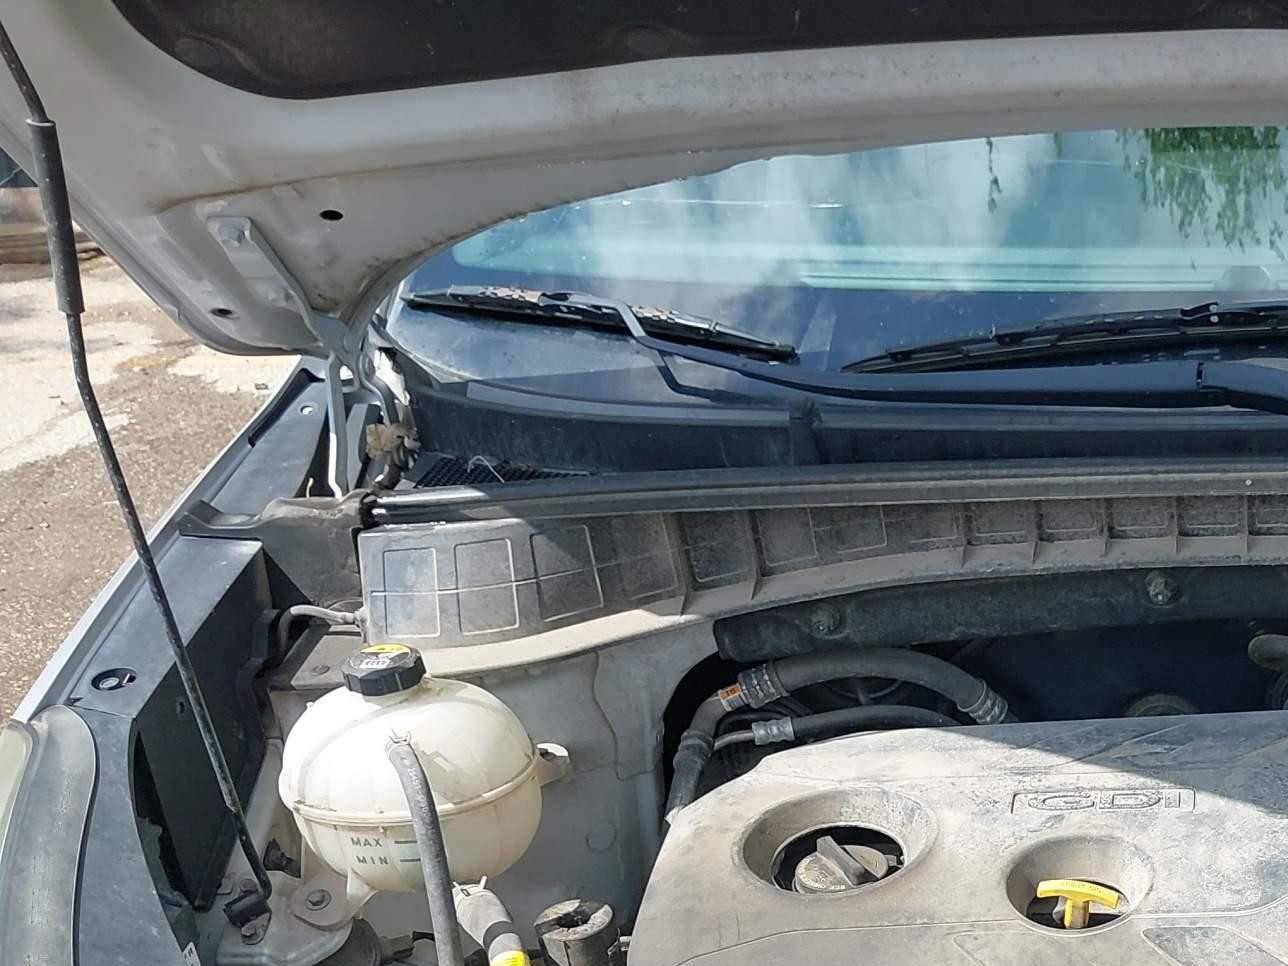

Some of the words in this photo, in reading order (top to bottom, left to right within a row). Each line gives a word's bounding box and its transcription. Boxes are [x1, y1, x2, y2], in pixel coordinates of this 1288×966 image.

[1027, 790, 1181, 811] GDI
[350, 837, 382, 847] MAX
[356, 855, 388, 865] MIN
